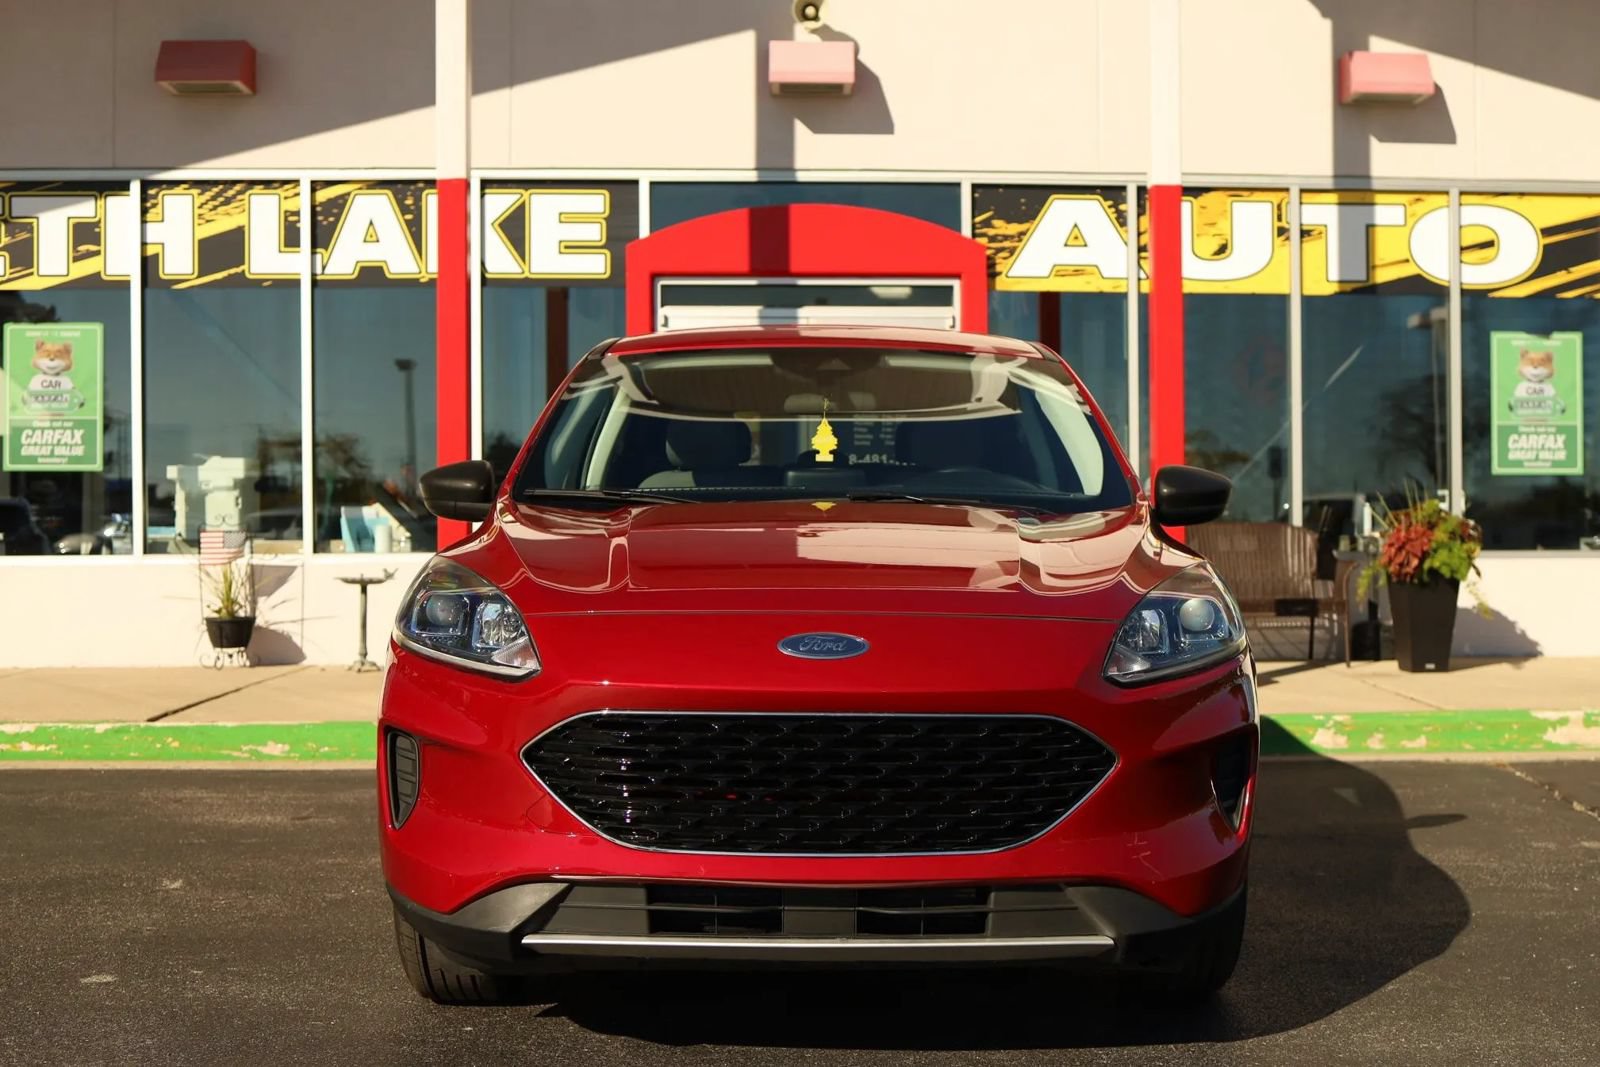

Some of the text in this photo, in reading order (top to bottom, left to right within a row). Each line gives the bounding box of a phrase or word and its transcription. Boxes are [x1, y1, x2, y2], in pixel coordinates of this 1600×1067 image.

[0, 189, 1543, 289] TH LAKE AUTO
[40, 379, 62, 389] CAR
[21, 429, 85, 444] CARFAX
[1508, 433, 1566, 448] CARFAX
[799, 635, 848, 651] Ford
